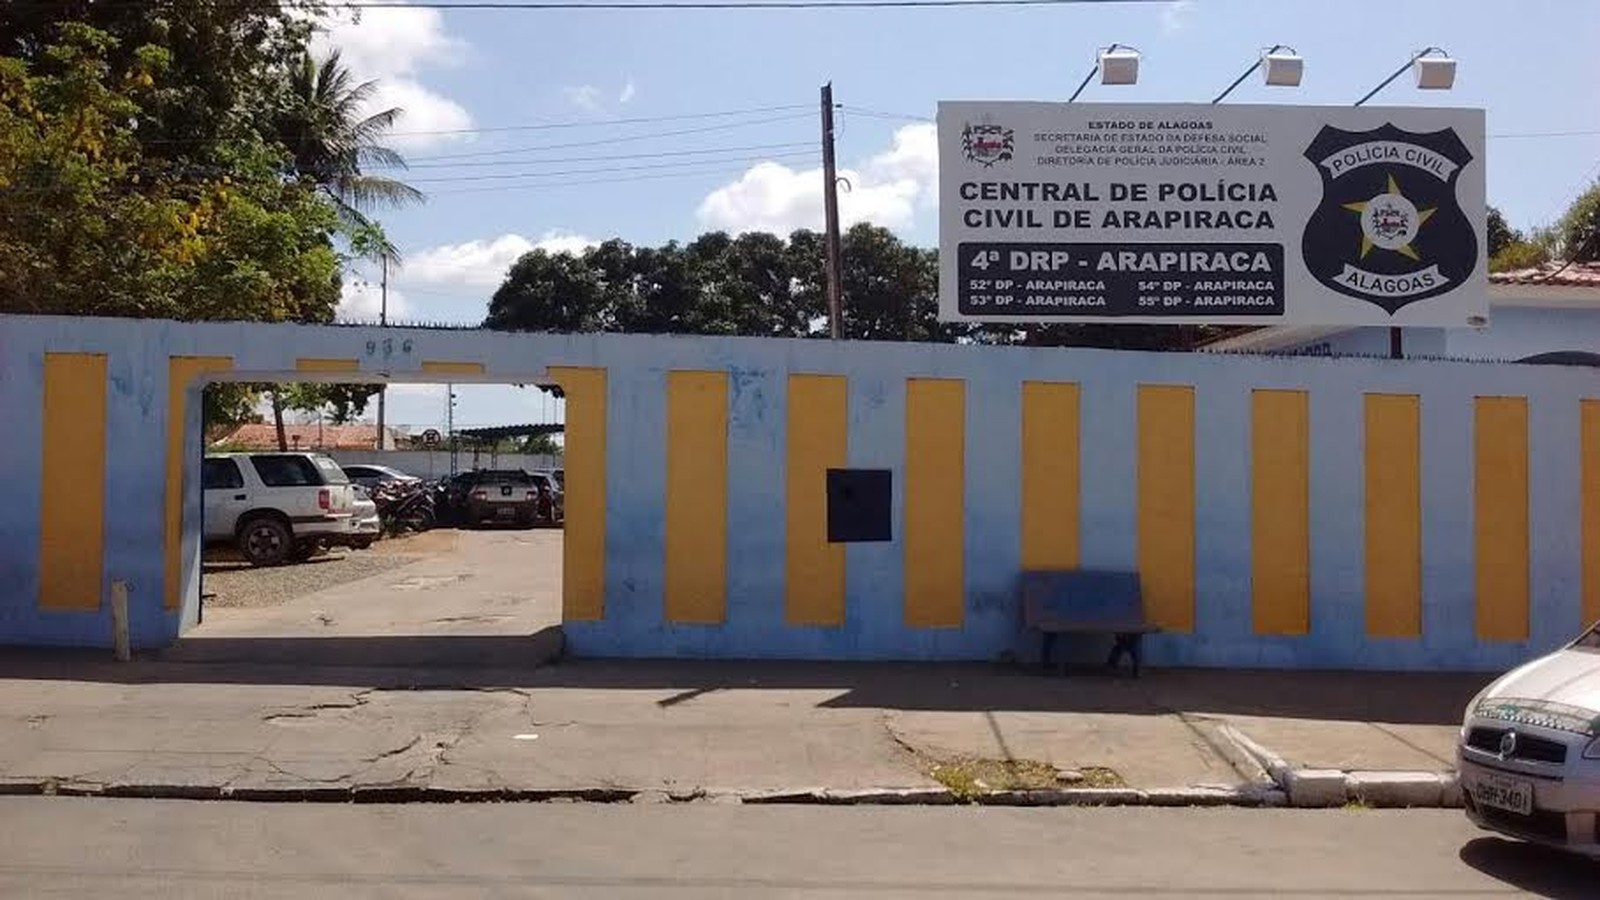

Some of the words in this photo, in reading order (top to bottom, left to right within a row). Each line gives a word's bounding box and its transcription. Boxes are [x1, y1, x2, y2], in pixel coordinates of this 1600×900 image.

[1088, 121, 1136, 130] ESTADO
[1138, 121, 1154, 130] DE
[1157, 121, 1214, 130] ALAGOAS
[1033, 133, 1101, 142] SECRETARIA
[1103, 133, 1118, 142] DE
[1120, 133, 1164, 142] ESTADO
[1166, 133, 1181, 142] DA
[1183, 133, 1226, 143] DEFESA
[1228, 133, 1267, 144] SOCIAL
[1055, 145, 1117, 154] DELEGACIA
[1119, 145, 1156, 154] GERAL
[1159, 145, 1174, 154] DA
[1220, 145, 1247, 154] CIVIL
[1037, 156, 1095, 166] DIRETORIA
[1097, 156, 1112, 166] DE
[1259, 157, 1266, 166] 2
[1332, 146, 1400, 173] POLÍCIA
[1405, 149, 1445, 176] CIVIL
[959, 182, 1100, 201] CENTRAL
[1110, 183, 1148, 201] DE
[1158, 179, 1278, 202] POLÍCIA
[963, 209, 1043, 228] CIVIL
[1053, 210, 1091, 228] DE
[1101, 210, 1275, 229] ARAPIRACA
[971, 251, 1000, 271] 4ª
[1010, 251, 1069, 271] DRP
[1096, 252, 1272, 272] ARAPIRACA
[995, 280, 1014, 291] DP
[1025, 280, 1106, 291] ARAPIRACA
[1163, 281, 1182, 291] DP
[1194, 281, 1275, 291] ARAPIRACA
[1346, 270, 1436, 294] ALAGOAS
[995, 295, 1014, 306] DP
[1025, 295, 1106, 306] ARAPIRACA
[1163, 296, 1182, 306] DP
[1194, 296, 1275, 306] ARAPIRACA
